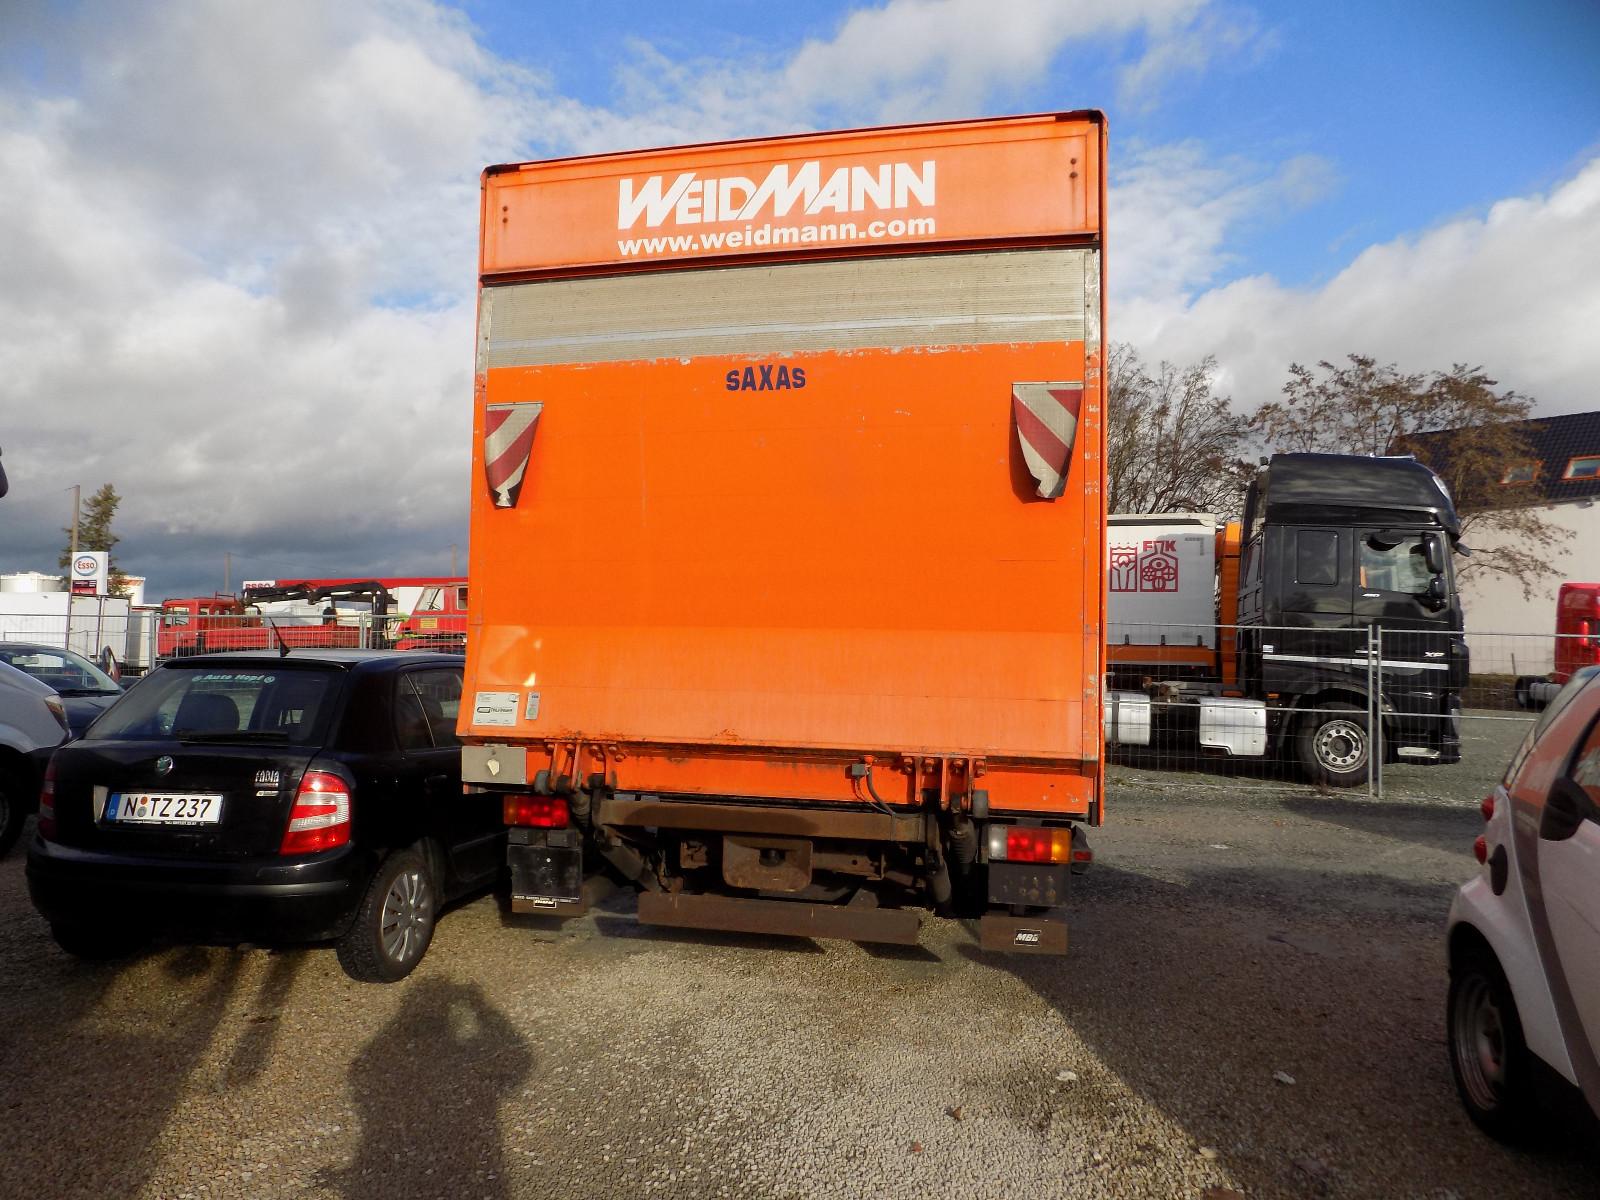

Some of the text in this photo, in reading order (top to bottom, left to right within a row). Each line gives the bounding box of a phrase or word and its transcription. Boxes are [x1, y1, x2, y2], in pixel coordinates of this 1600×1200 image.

[617, 160, 936, 230] WEIDMANN
[617, 217, 936, 256] www.weidmann.com
[726, 364, 806, 391] SAXAS
[123, 797, 212, 819] N TZ 237
